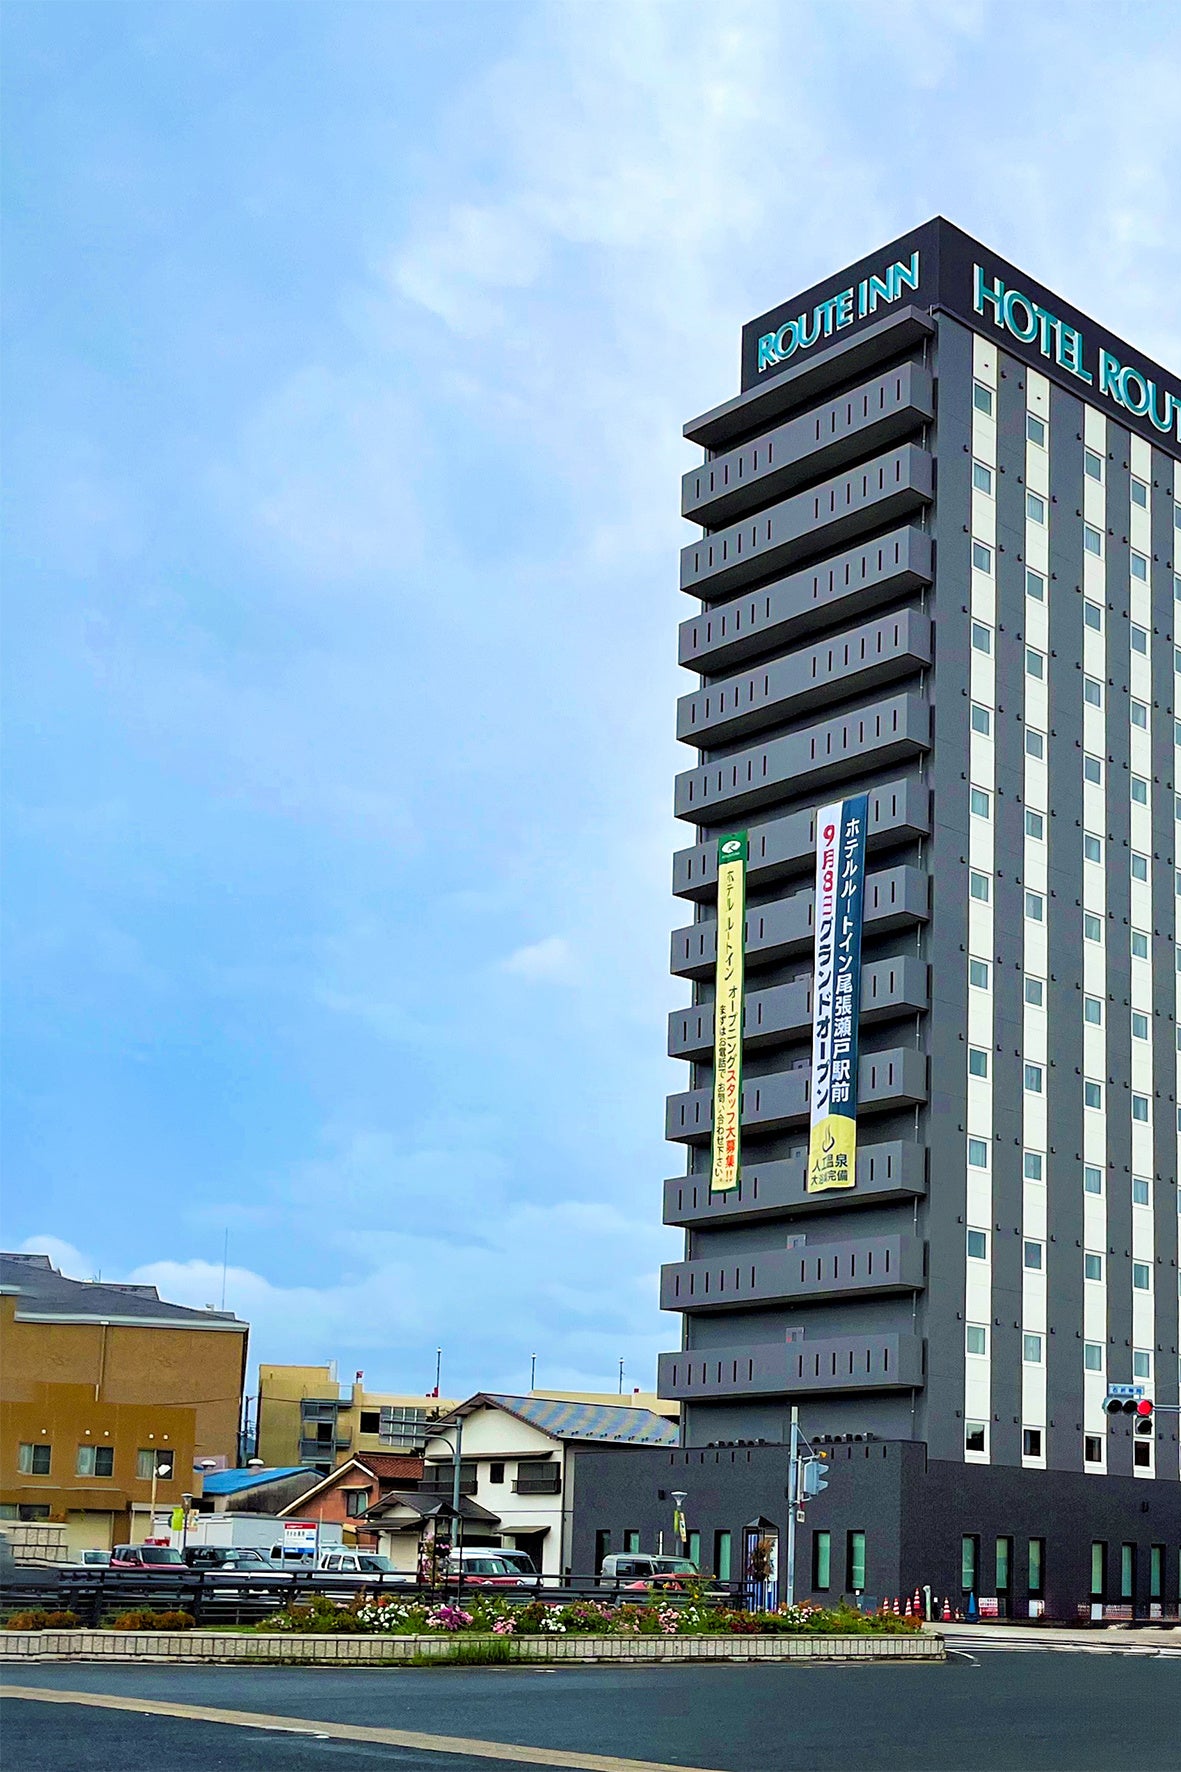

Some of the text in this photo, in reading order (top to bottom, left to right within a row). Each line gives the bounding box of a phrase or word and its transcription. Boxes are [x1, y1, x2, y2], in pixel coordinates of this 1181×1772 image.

[758, 250, 920, 374] ROUTE INN
[973, 262, 1093, 387] HOTEL
